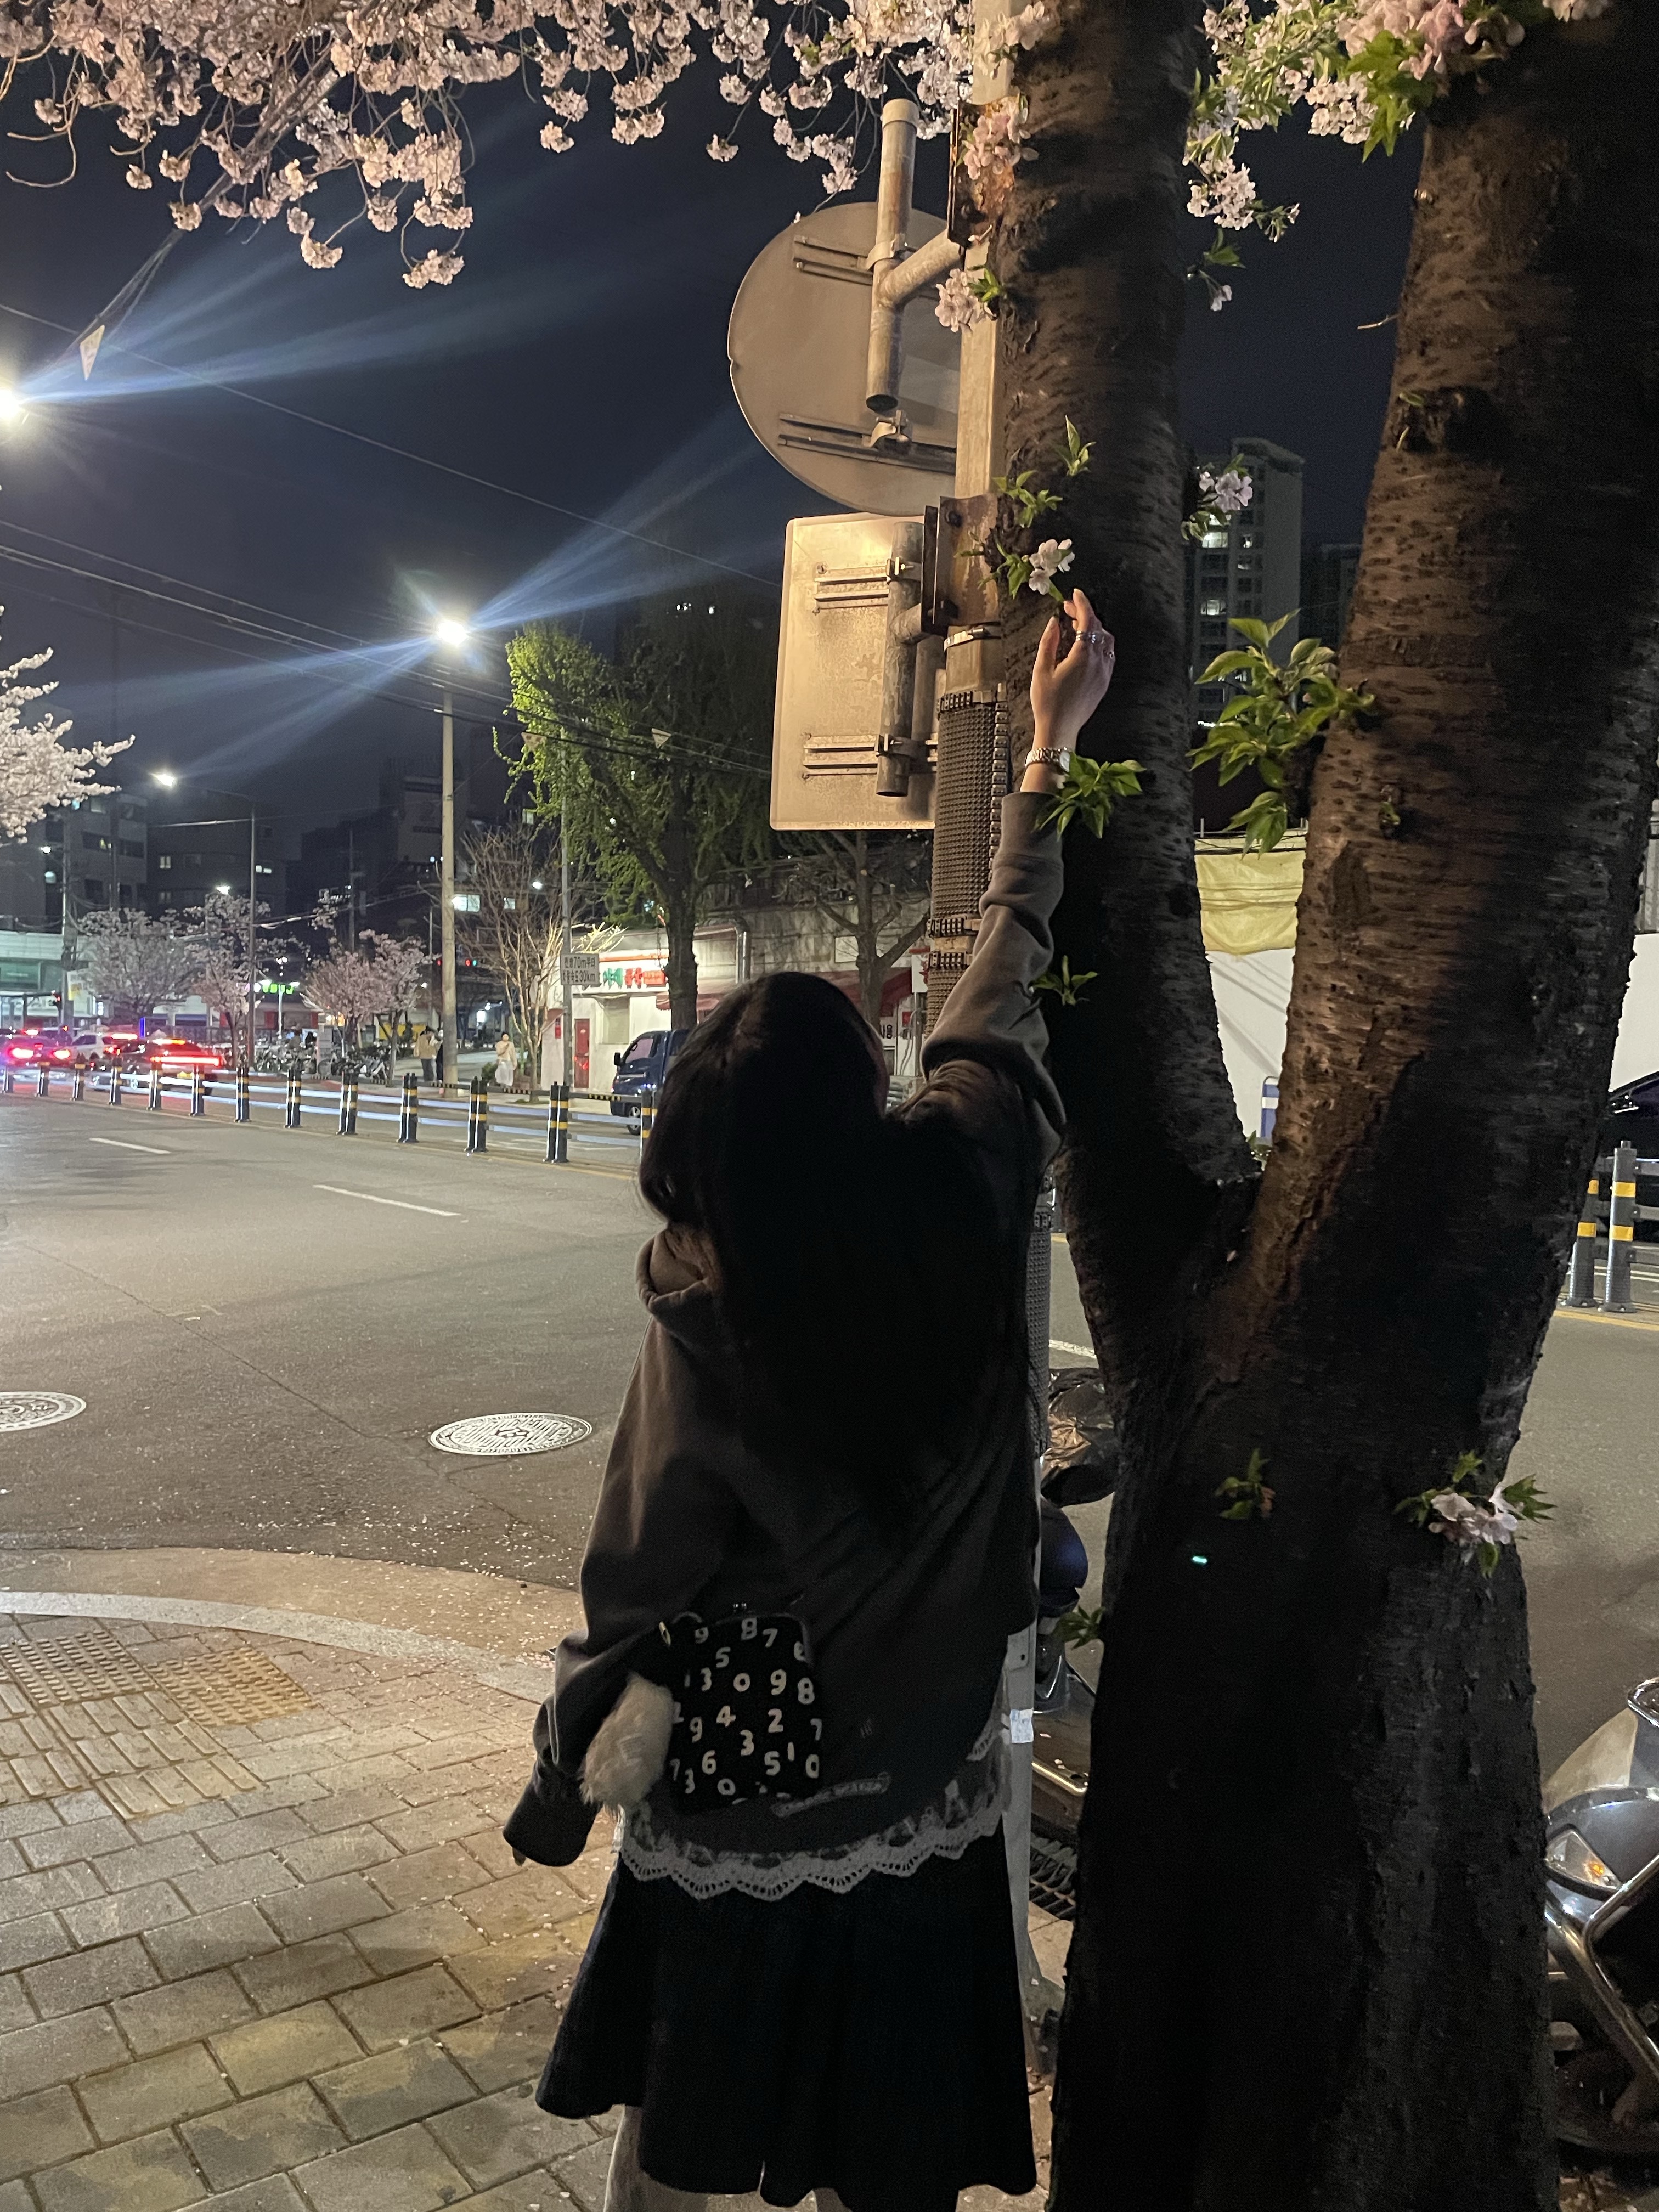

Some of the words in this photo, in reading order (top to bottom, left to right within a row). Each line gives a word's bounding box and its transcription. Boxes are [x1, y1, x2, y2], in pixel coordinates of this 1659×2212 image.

[695, 1627, 709, 1644] 9
[741, 1616, 757, 1640] 8
[763, 1628, 778, 1648] 7
[716, 1647, 731, 1668] 5
[701, 1667, 712, 1691] 3
[733, 1673, 751, 1692] 0
[770, 1669, 787, 1696] 9
[797, 1677, 815, 1705] 8
[716, 1705, 736, 1728] 4
[768, 1708, 784, 1733] 2
[690, 1716, 703, 1743] 9
[810, 1718, 822, 1741] 7
[740, 1729, 755, 1756] 3
[787, 1742, 795, 1762] 1
[701, 1750, 716, 1775] 6
[764, 1751, 781, 1776] 5
[805, 1754, 820, 1779] 0
[685, 1768, 695, 1794] 3
[717, 1778, 736, 1796] 0
